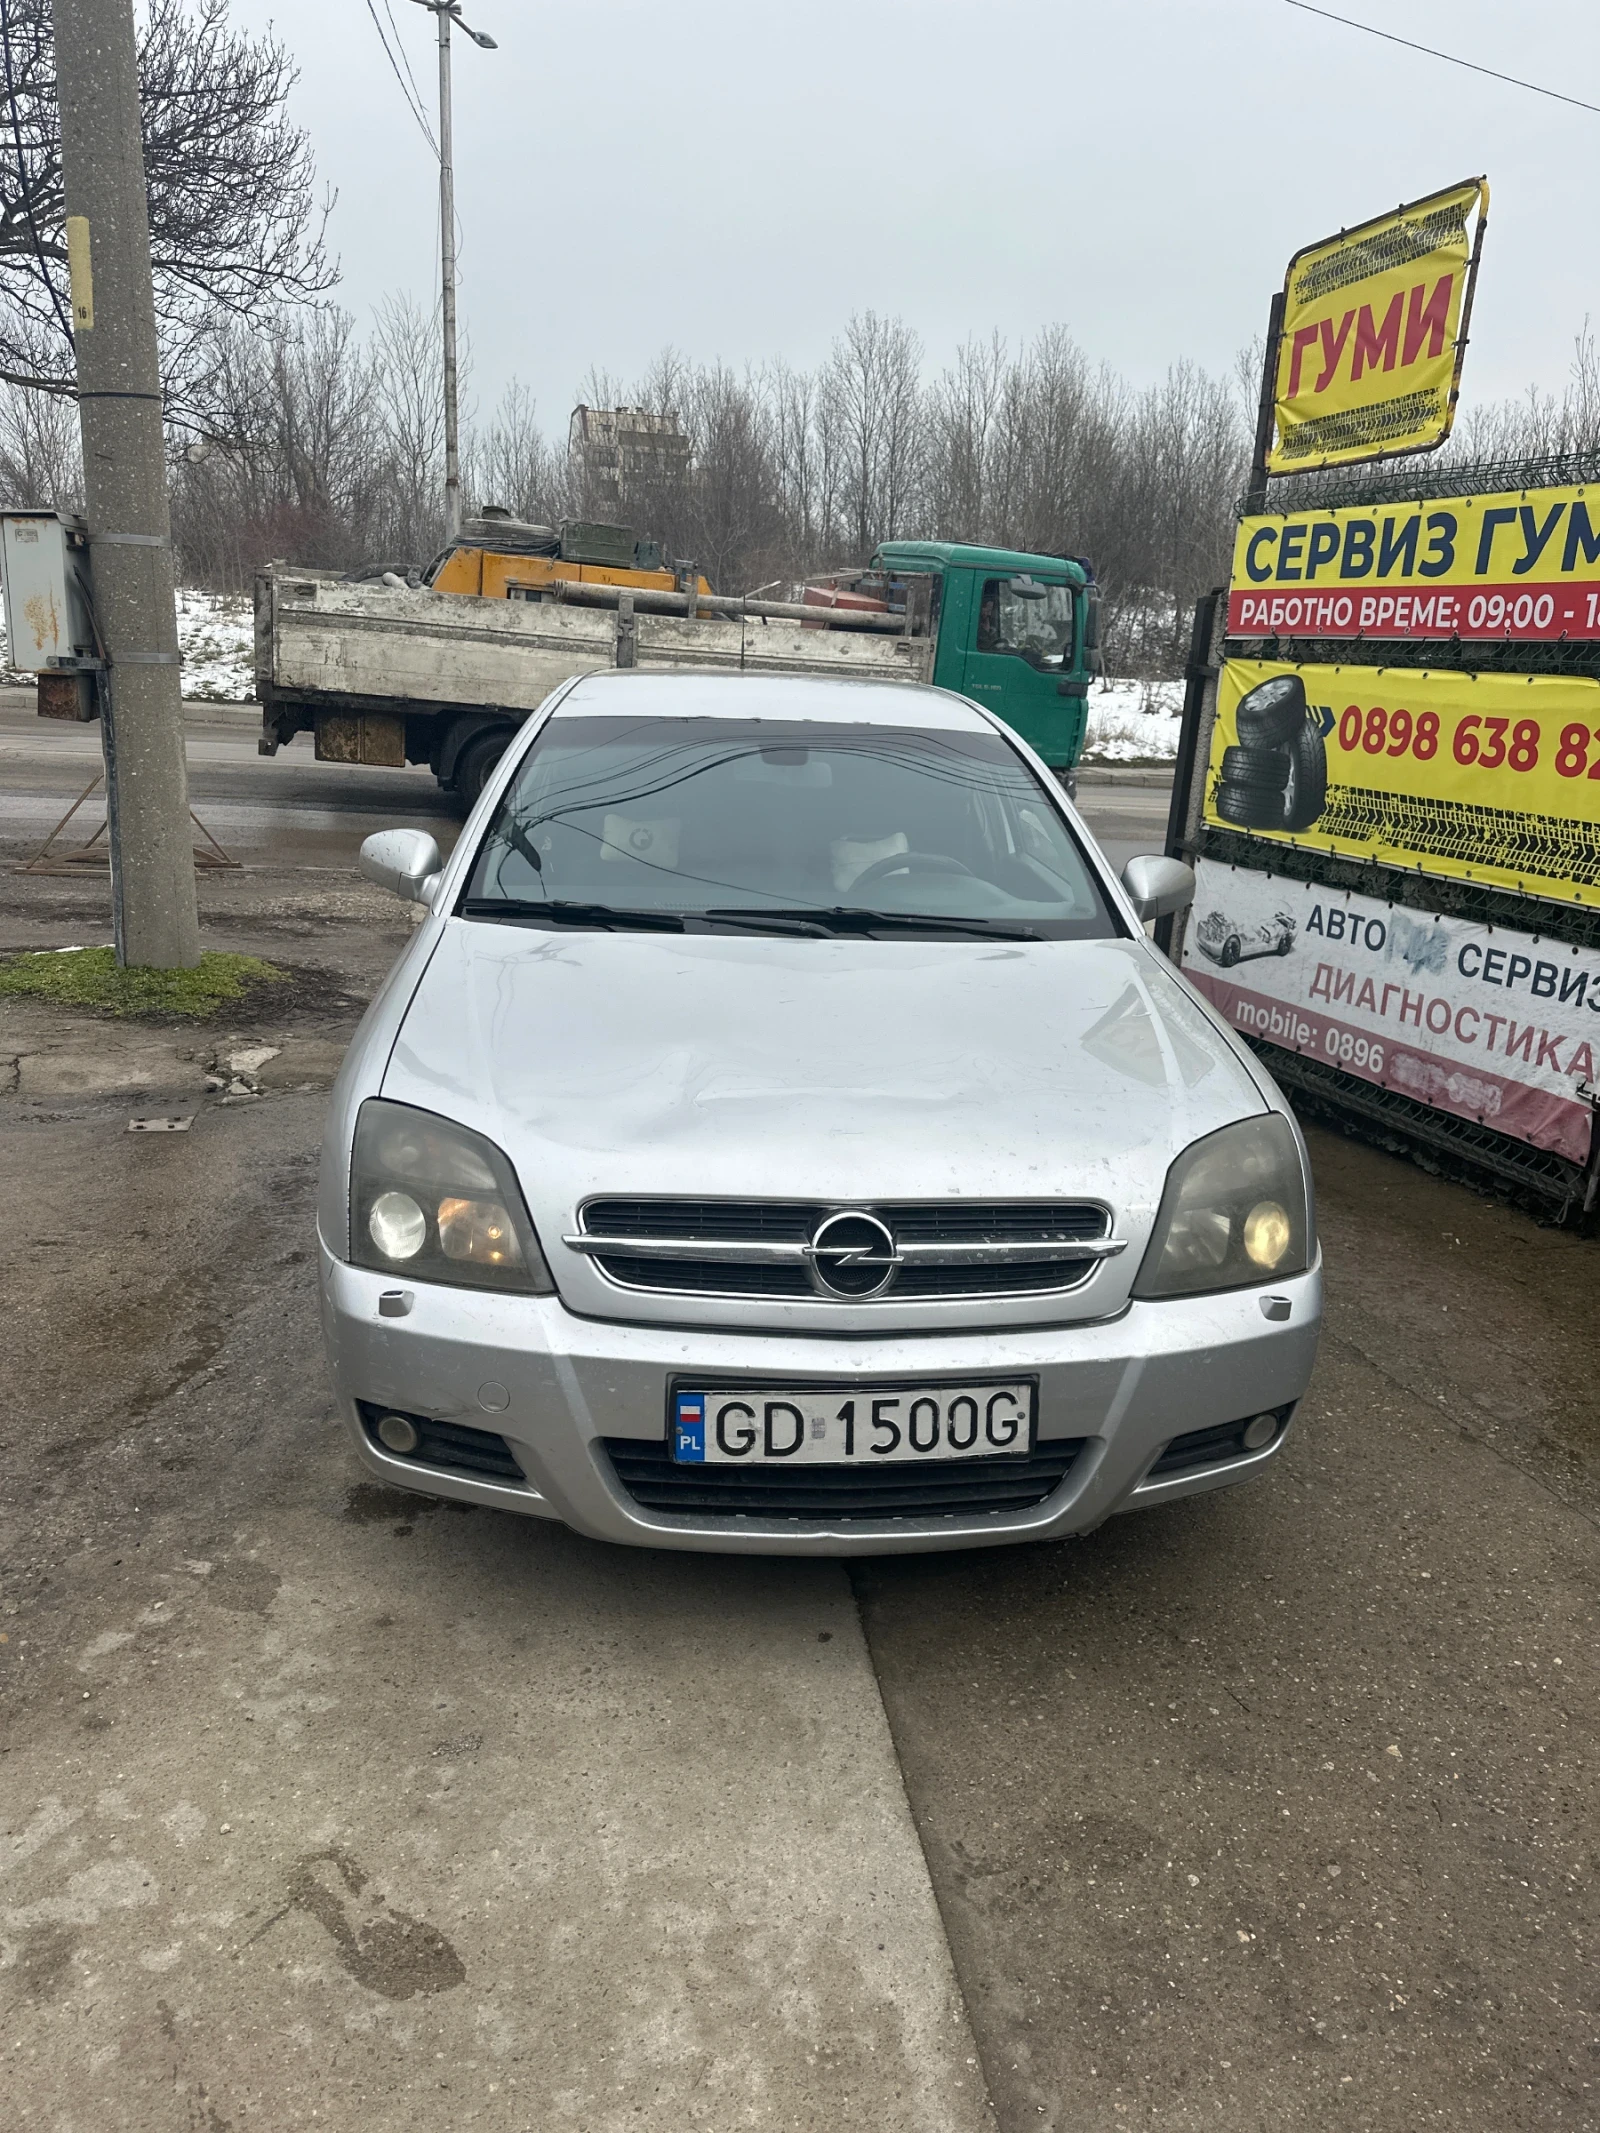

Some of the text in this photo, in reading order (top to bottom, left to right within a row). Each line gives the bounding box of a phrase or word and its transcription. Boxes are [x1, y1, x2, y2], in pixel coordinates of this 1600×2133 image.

[78, 306, 87, 319] 16
[1286, 273, 1454, 400] ГУМИ
[1245, 512, 1458, 583] СЕРВИЗ
[1239, 596, 1353, 627] РАБОТНО
[1358, 596, 1461, 628] ВРЕМЕ:
[1467, 593, 1555, 629] 09:00
[1585, 593, 1600, 629] 1
[1338, 704, 1441, 761] 0898
[1452, 714, 1541, 773] 638
[1305, 904, 1387, 952] АВТО
[1236, 999, 1385, 1074] mobile: 0896
[1308, 962, 1595, 1085] ДИАГНОСТИКА
[679, 1435, 701, 1451] PL
[716, 1390, 1020, 1457] GD 1500G
